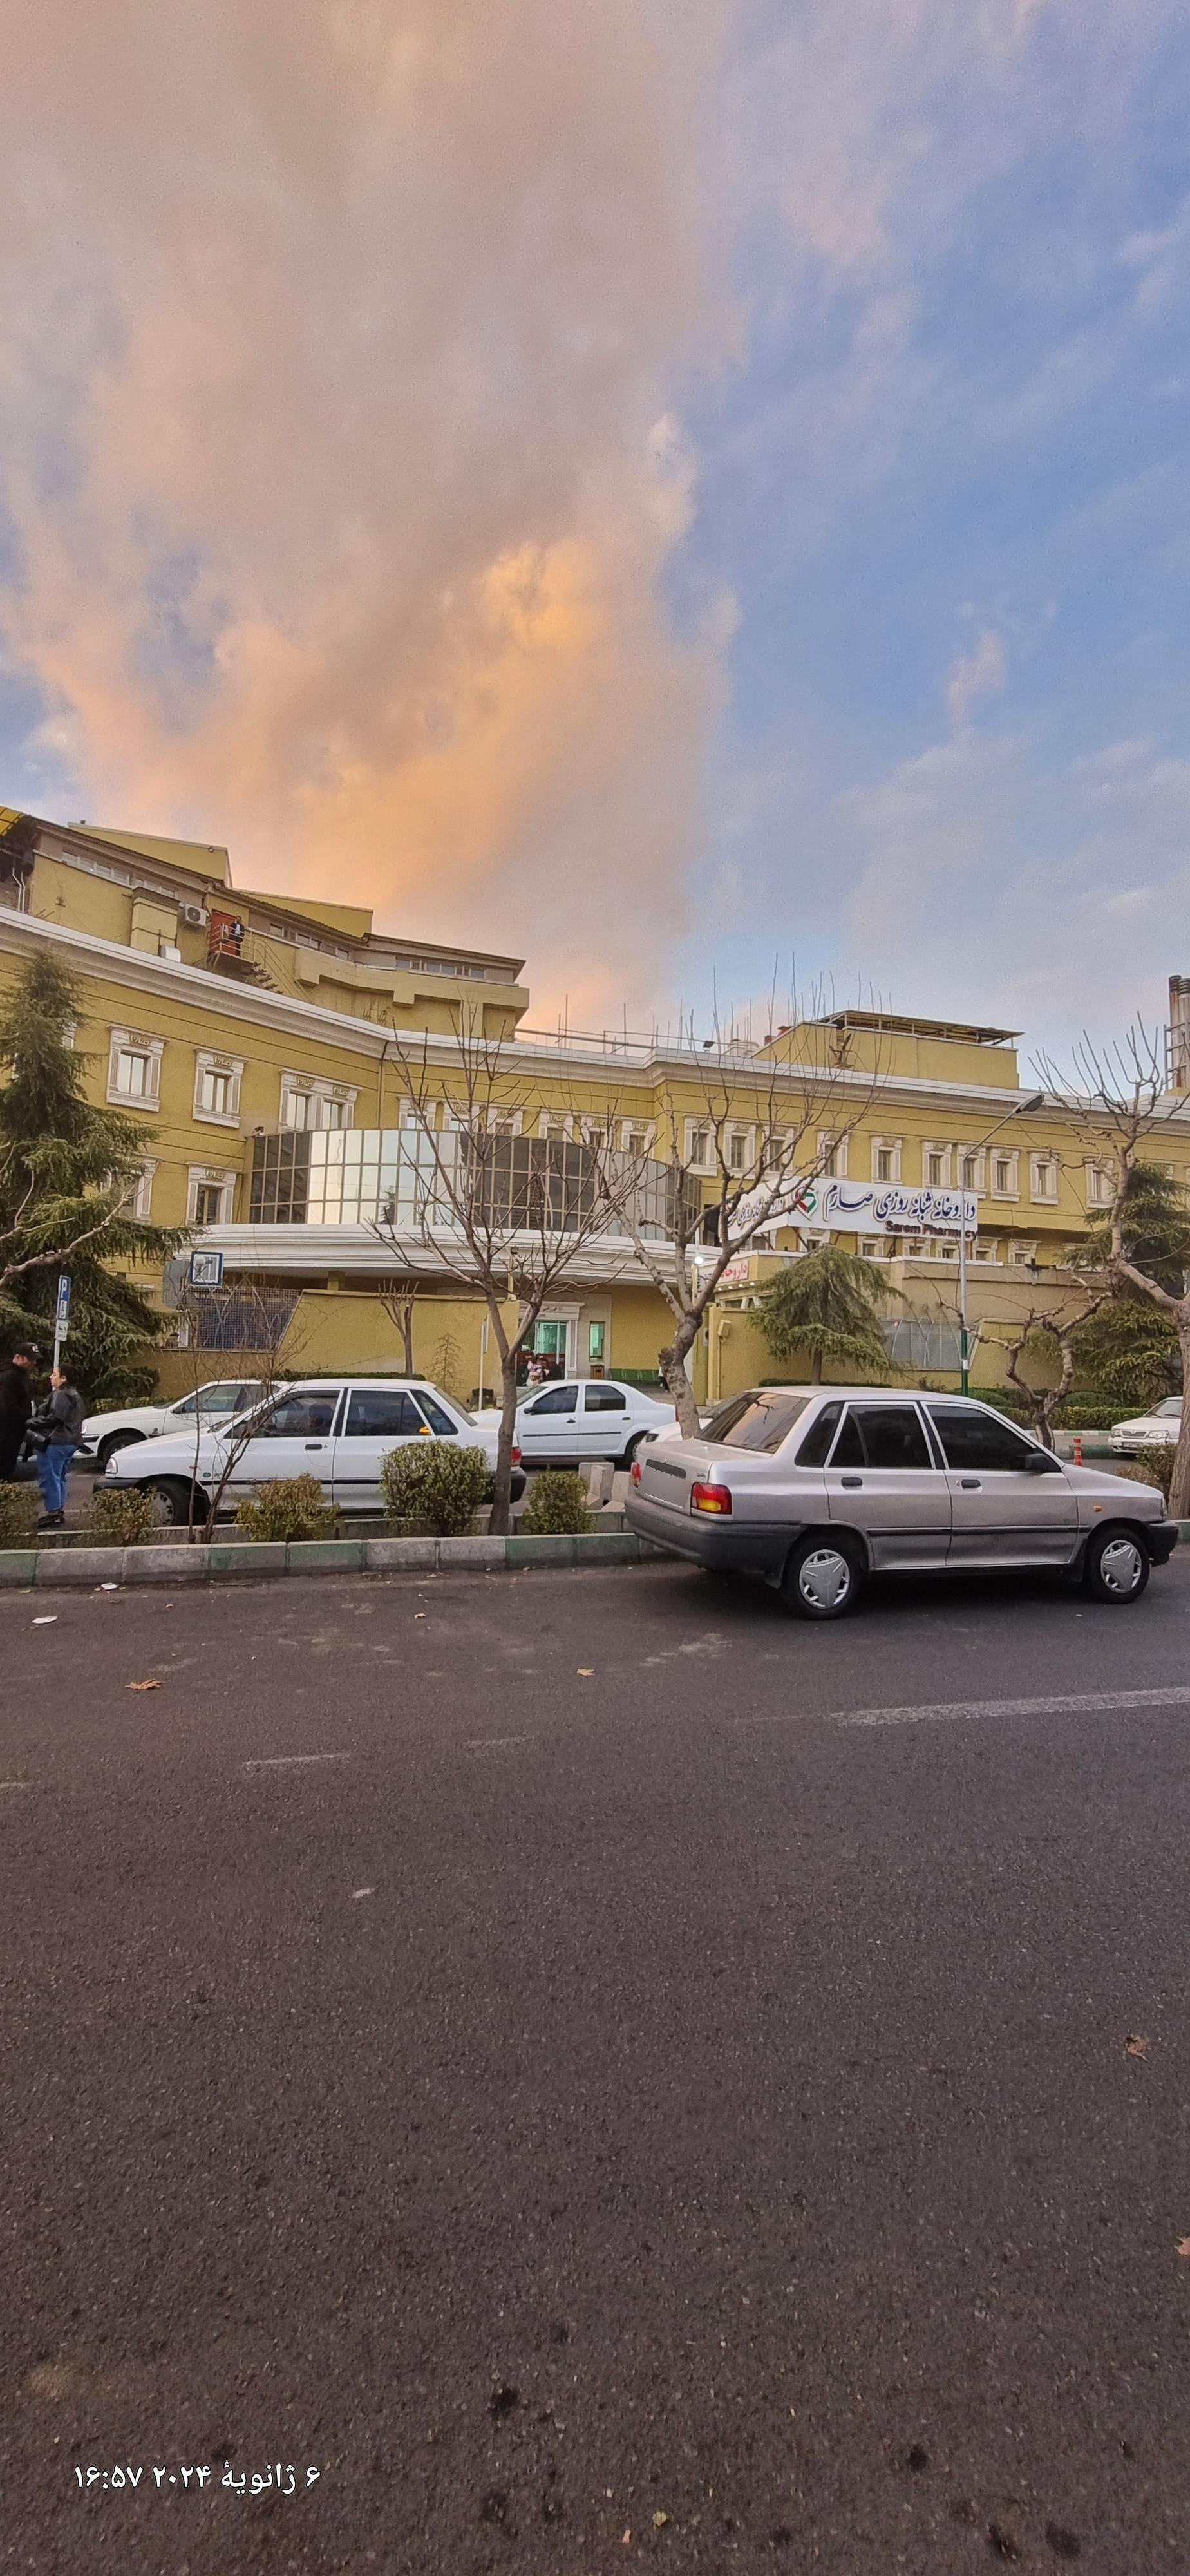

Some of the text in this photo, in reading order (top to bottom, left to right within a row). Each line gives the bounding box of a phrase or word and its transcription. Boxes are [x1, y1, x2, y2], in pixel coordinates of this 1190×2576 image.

[824, 1184, 873, 1220] صارم
[932, 1196, 976, 1220] داوخانه
[885, 1220, 978, 1242] Sarem Pharmcy
[61, 1278, 67, 1299] P
